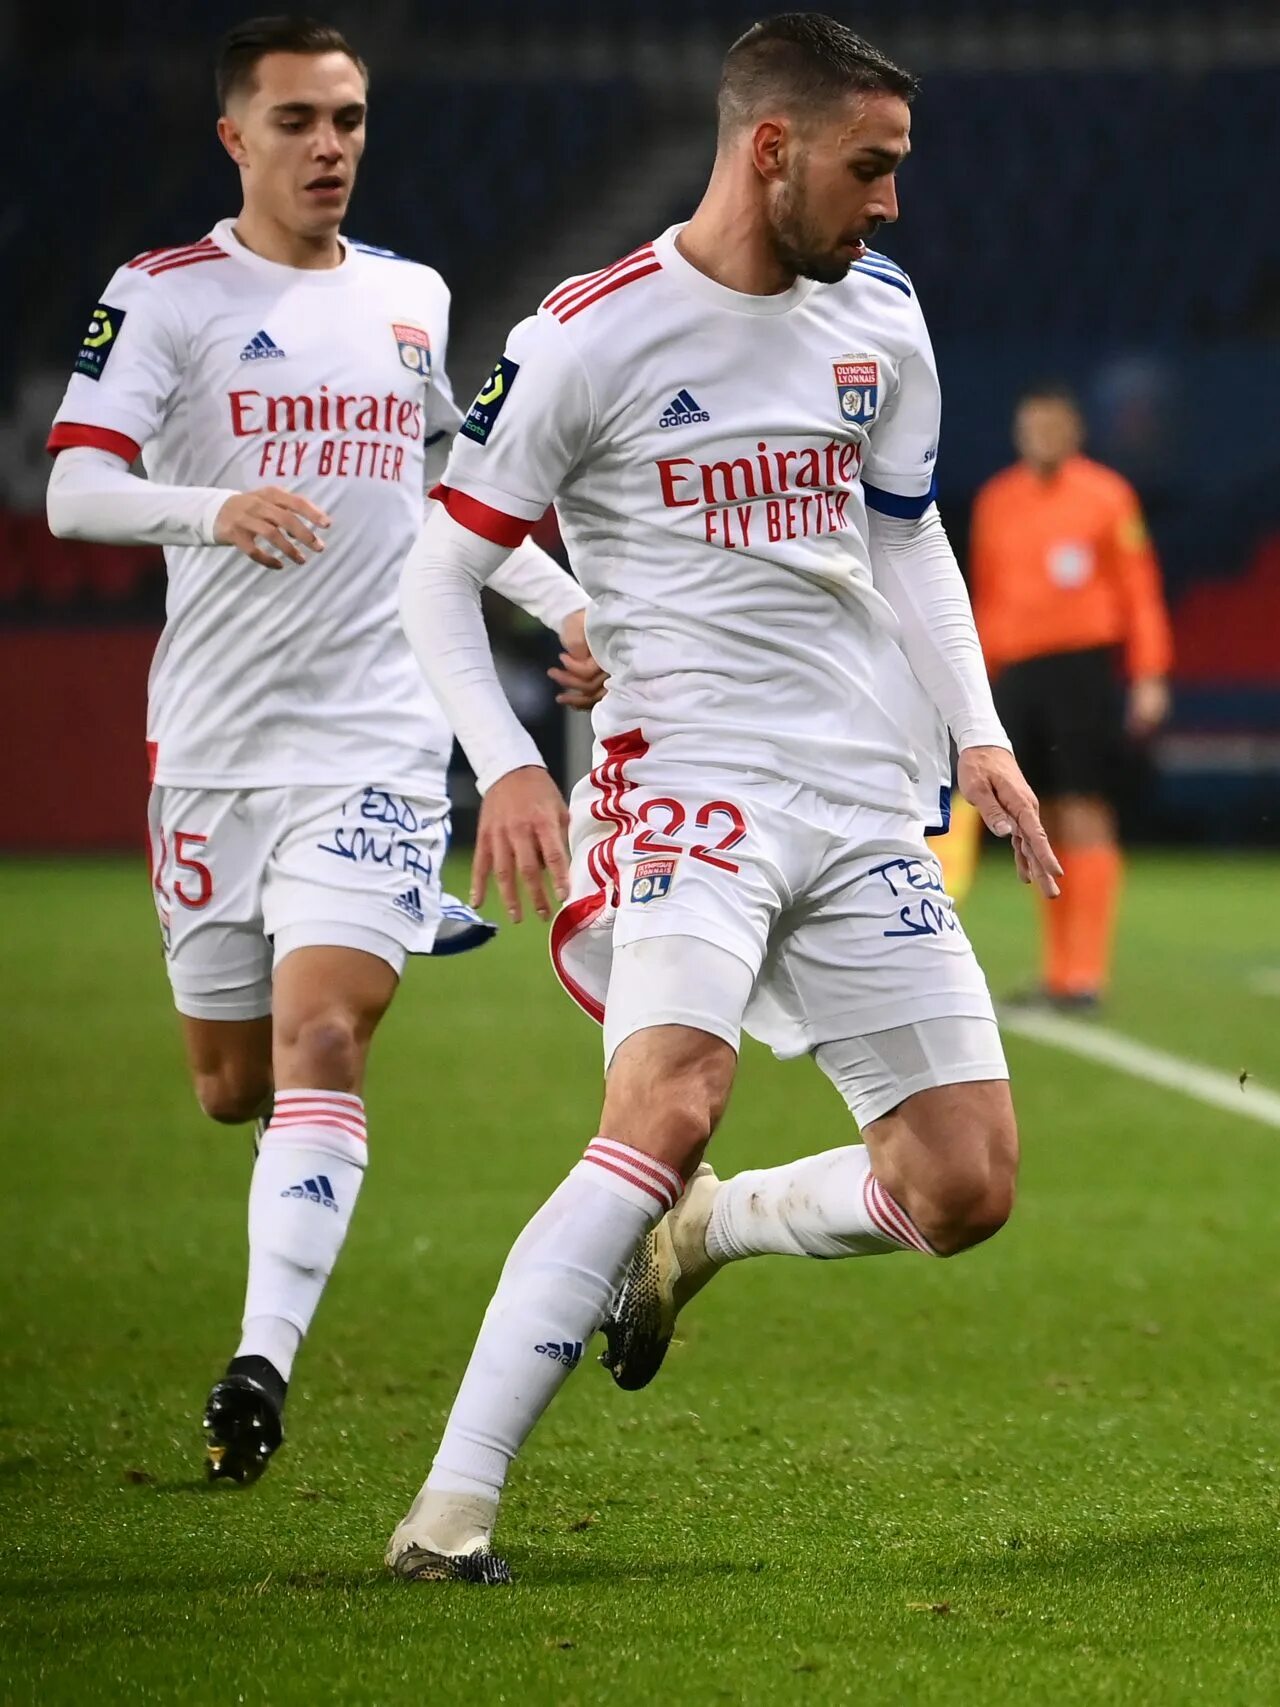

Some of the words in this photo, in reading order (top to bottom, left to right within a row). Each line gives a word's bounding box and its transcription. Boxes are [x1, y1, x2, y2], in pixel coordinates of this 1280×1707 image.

[837, 365, 876, 375] OLYMPIQUE
[838, 374, 876, 384] LYONNAIS
[228, 385, 422, 441] Emirates
[659, 411, 710, 429] adidas
[258, 441, 308, 477] FLY
[318, 441, 404, 481] BETTER
[705, 505, 752, 549] FLY
[766, 490, 850, 543] BETTER
[633, 797, 747, 874] 22
